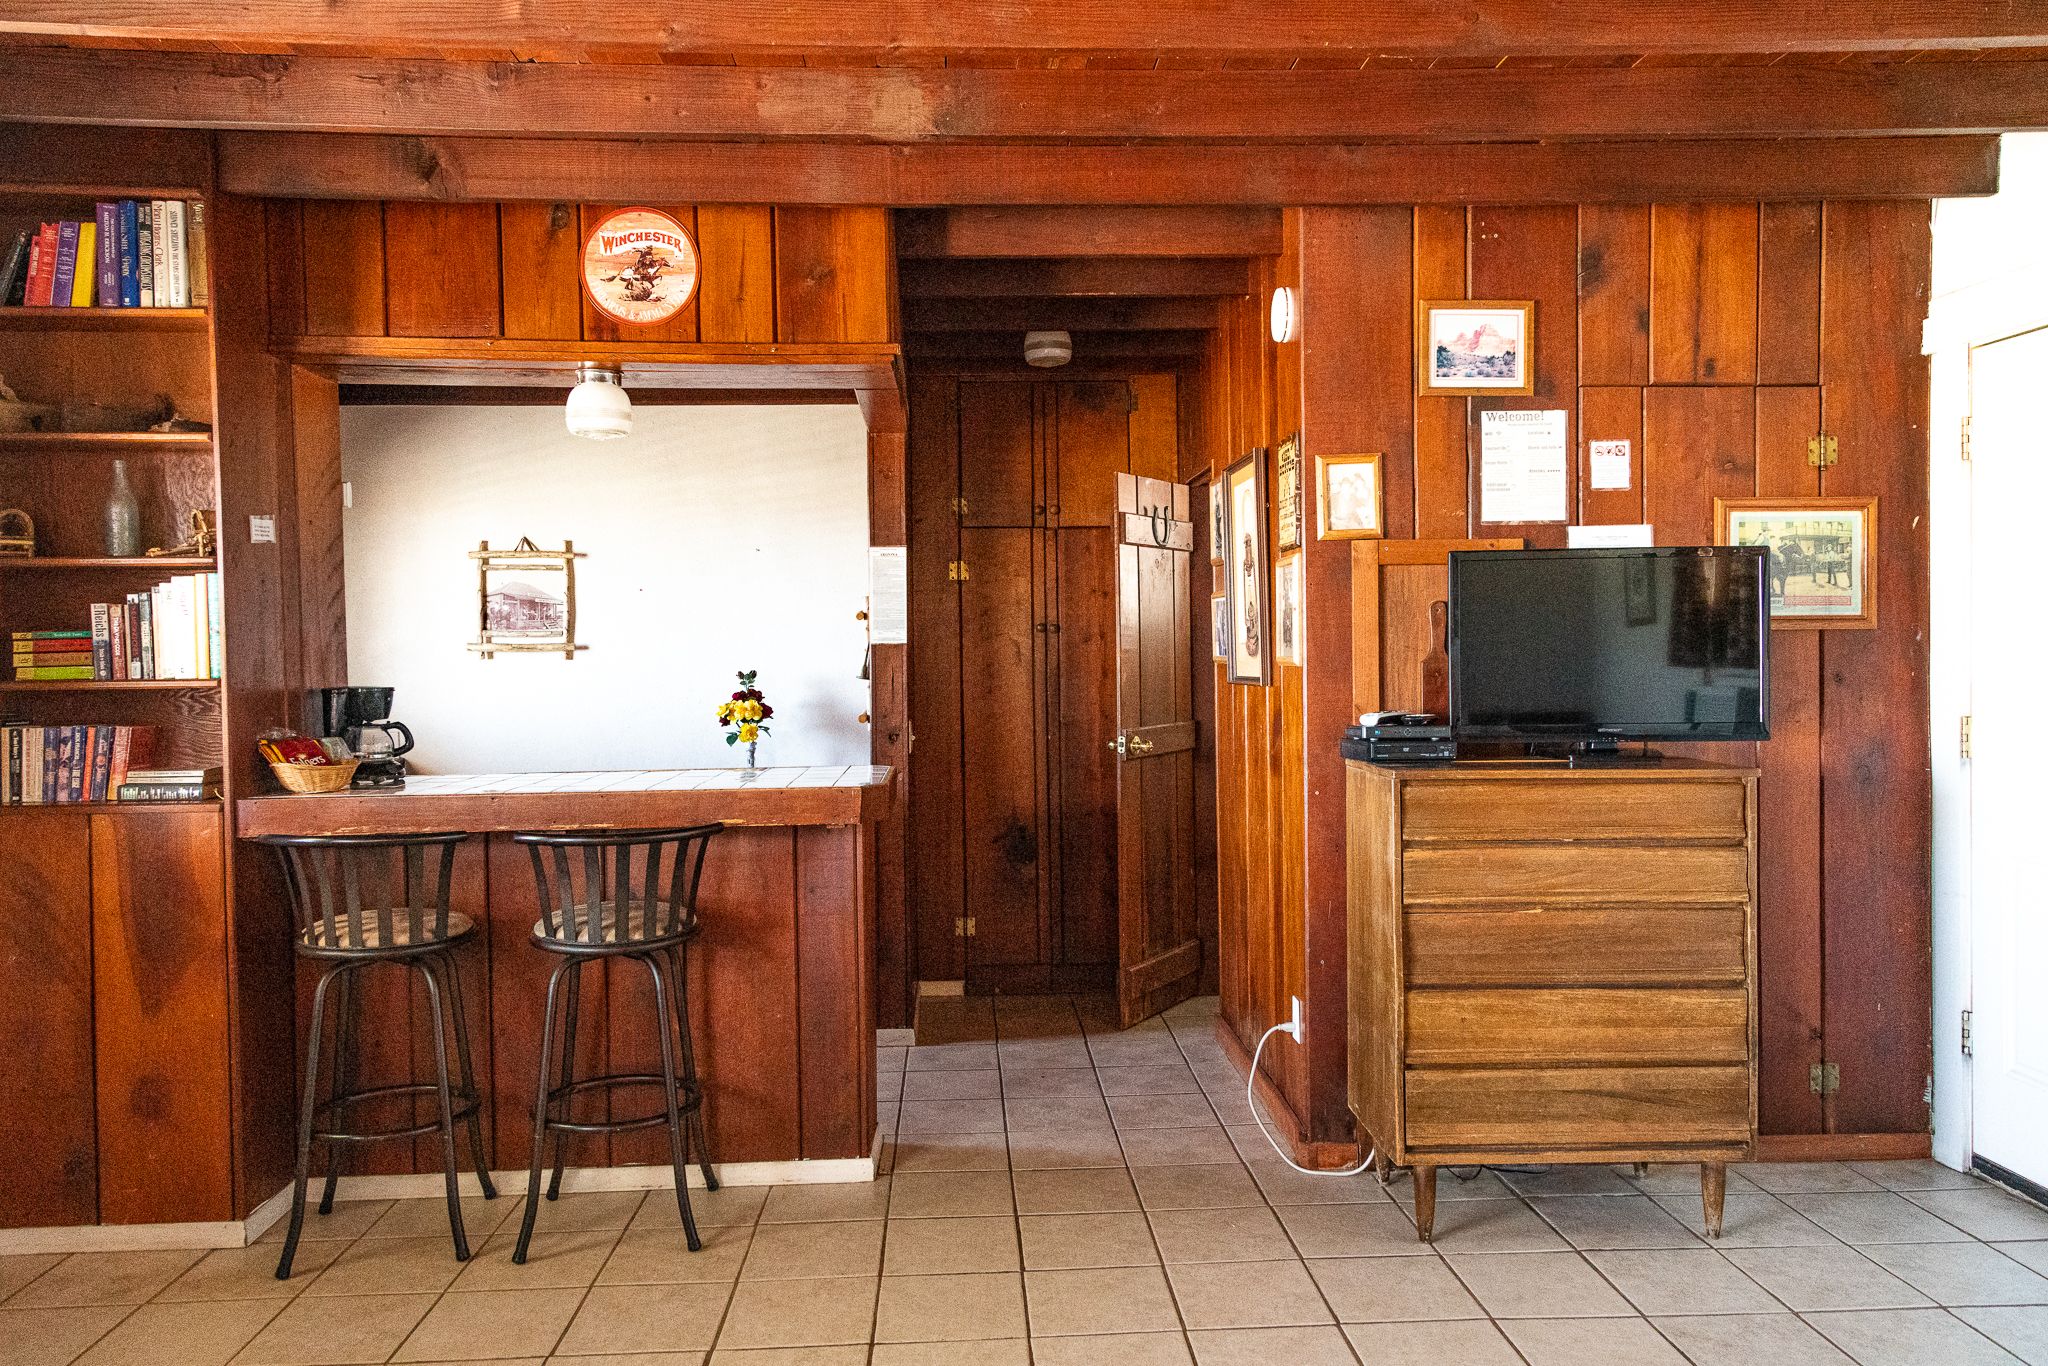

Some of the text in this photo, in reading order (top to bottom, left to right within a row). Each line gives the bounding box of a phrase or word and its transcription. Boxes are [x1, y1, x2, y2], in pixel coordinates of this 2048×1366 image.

[153, 204, 163, 222] Mary
[154, 223, 163, 247] Higgins
[170, 230, 179, 252] SHELDON
[601, 231, 682, 254] WINCHESTER
[155, 247, 164, 267] Clark
[1486, 411, 1544, 422] Welcome!
[94, 610, 107, 638] Reichs
